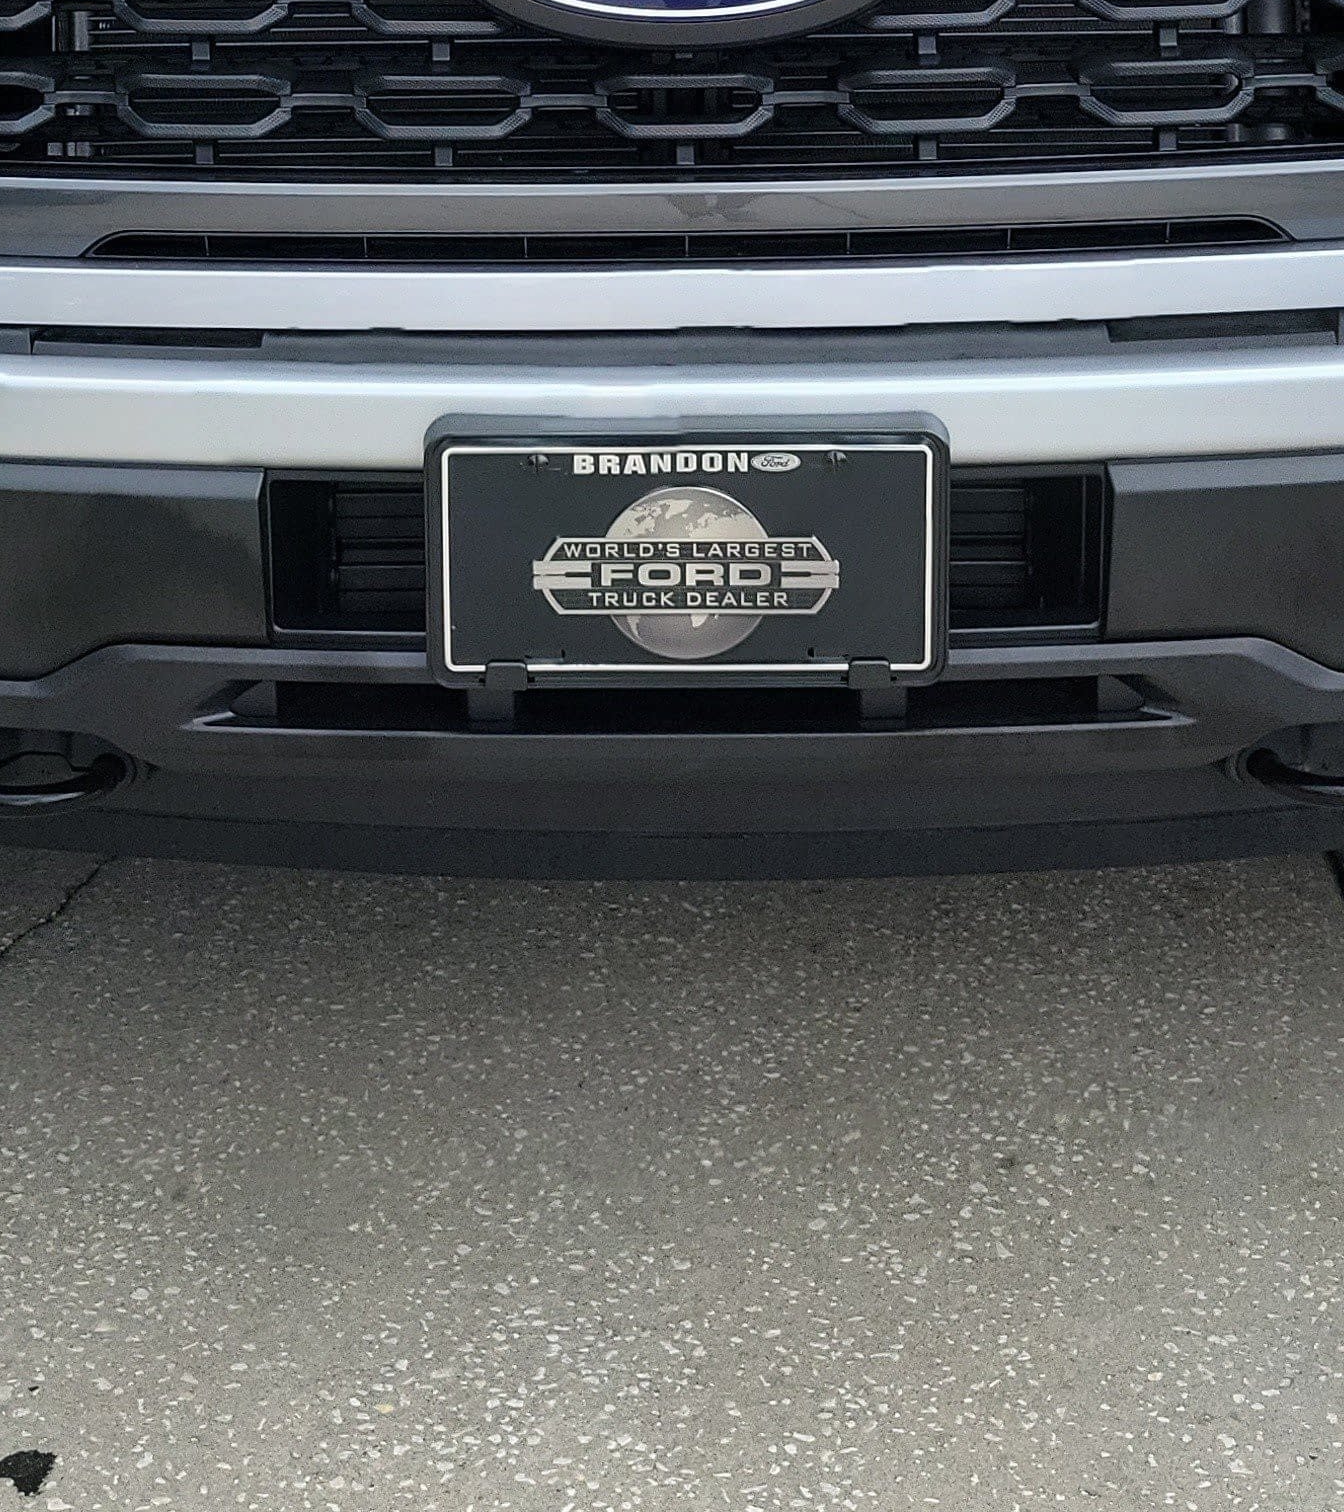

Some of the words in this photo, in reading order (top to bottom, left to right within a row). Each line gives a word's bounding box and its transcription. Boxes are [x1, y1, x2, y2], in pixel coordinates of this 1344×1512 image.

[573, 452, 749, 475] BRANDON
[563, 542, 681, 559] WORLD'S
[692, 542, 812, 558] LARGEST
[601, 562, 773, 587] FORD
[588, 592, 674, 607] TRUCK
[692, 591, 789, 607] DEALER
